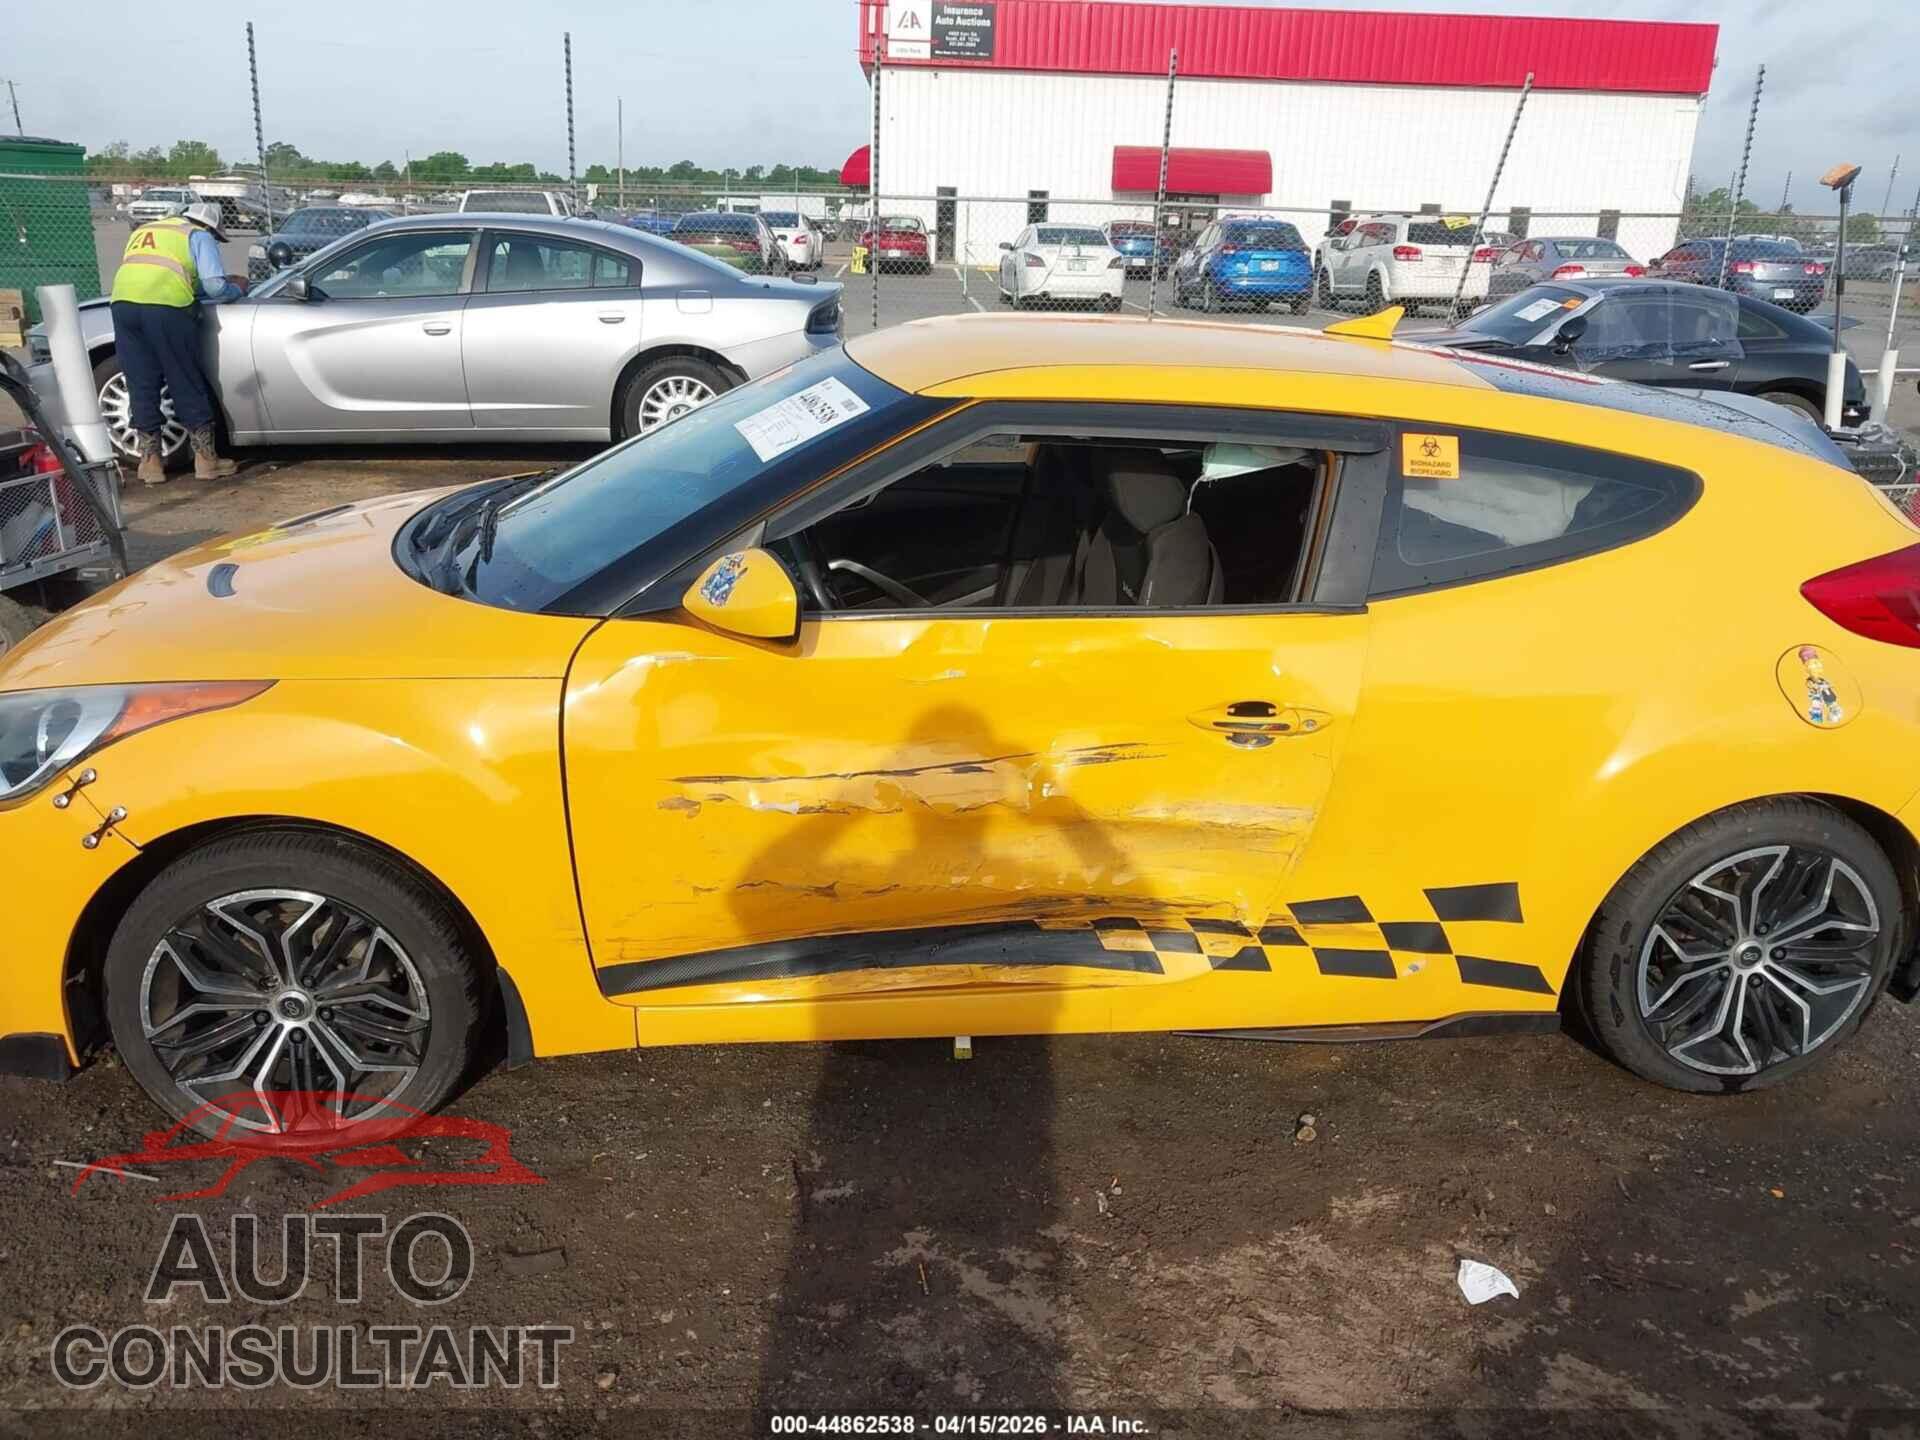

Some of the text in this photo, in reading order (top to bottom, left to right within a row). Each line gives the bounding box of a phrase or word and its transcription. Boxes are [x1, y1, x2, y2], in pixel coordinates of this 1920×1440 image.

[944, 5, 984, 16] Insurance
[935, 15, 991, 27] Auto Auctions
[1410, 459, 1452, 468] BIOHAZARD
